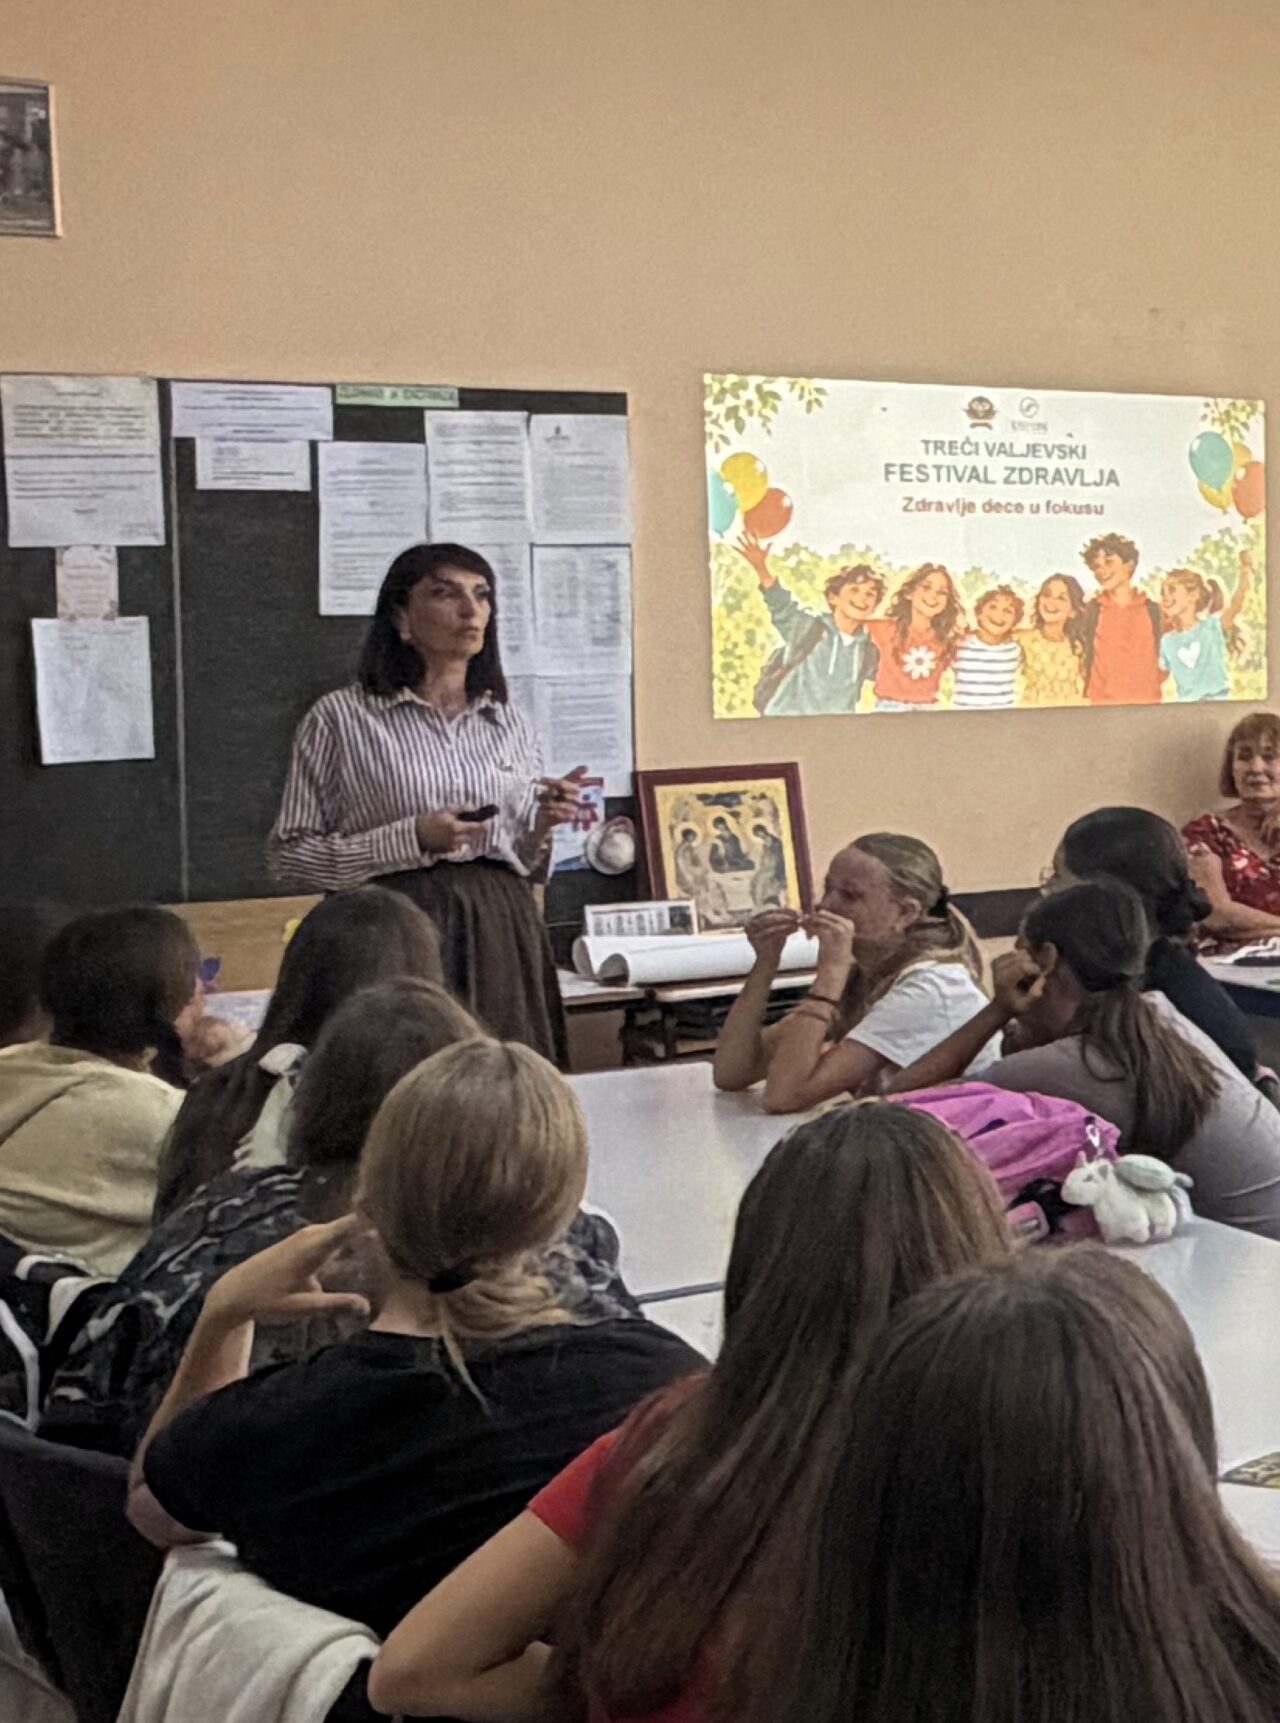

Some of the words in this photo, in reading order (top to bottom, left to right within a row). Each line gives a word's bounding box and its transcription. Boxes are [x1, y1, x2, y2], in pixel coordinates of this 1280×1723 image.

[984, 441, 1087, 460] VALJEVSKI
[884, 462, 997, 484] FESTIVAL
[1003, 466, 1120, 487] ZDRAVLJA
[902, 496, 976, 517] Zdravlje
[981, 498, 1025, 514] dece
[1029, 503, 1041, 514] u
[1045, 499, 1105, 515] fokusu
